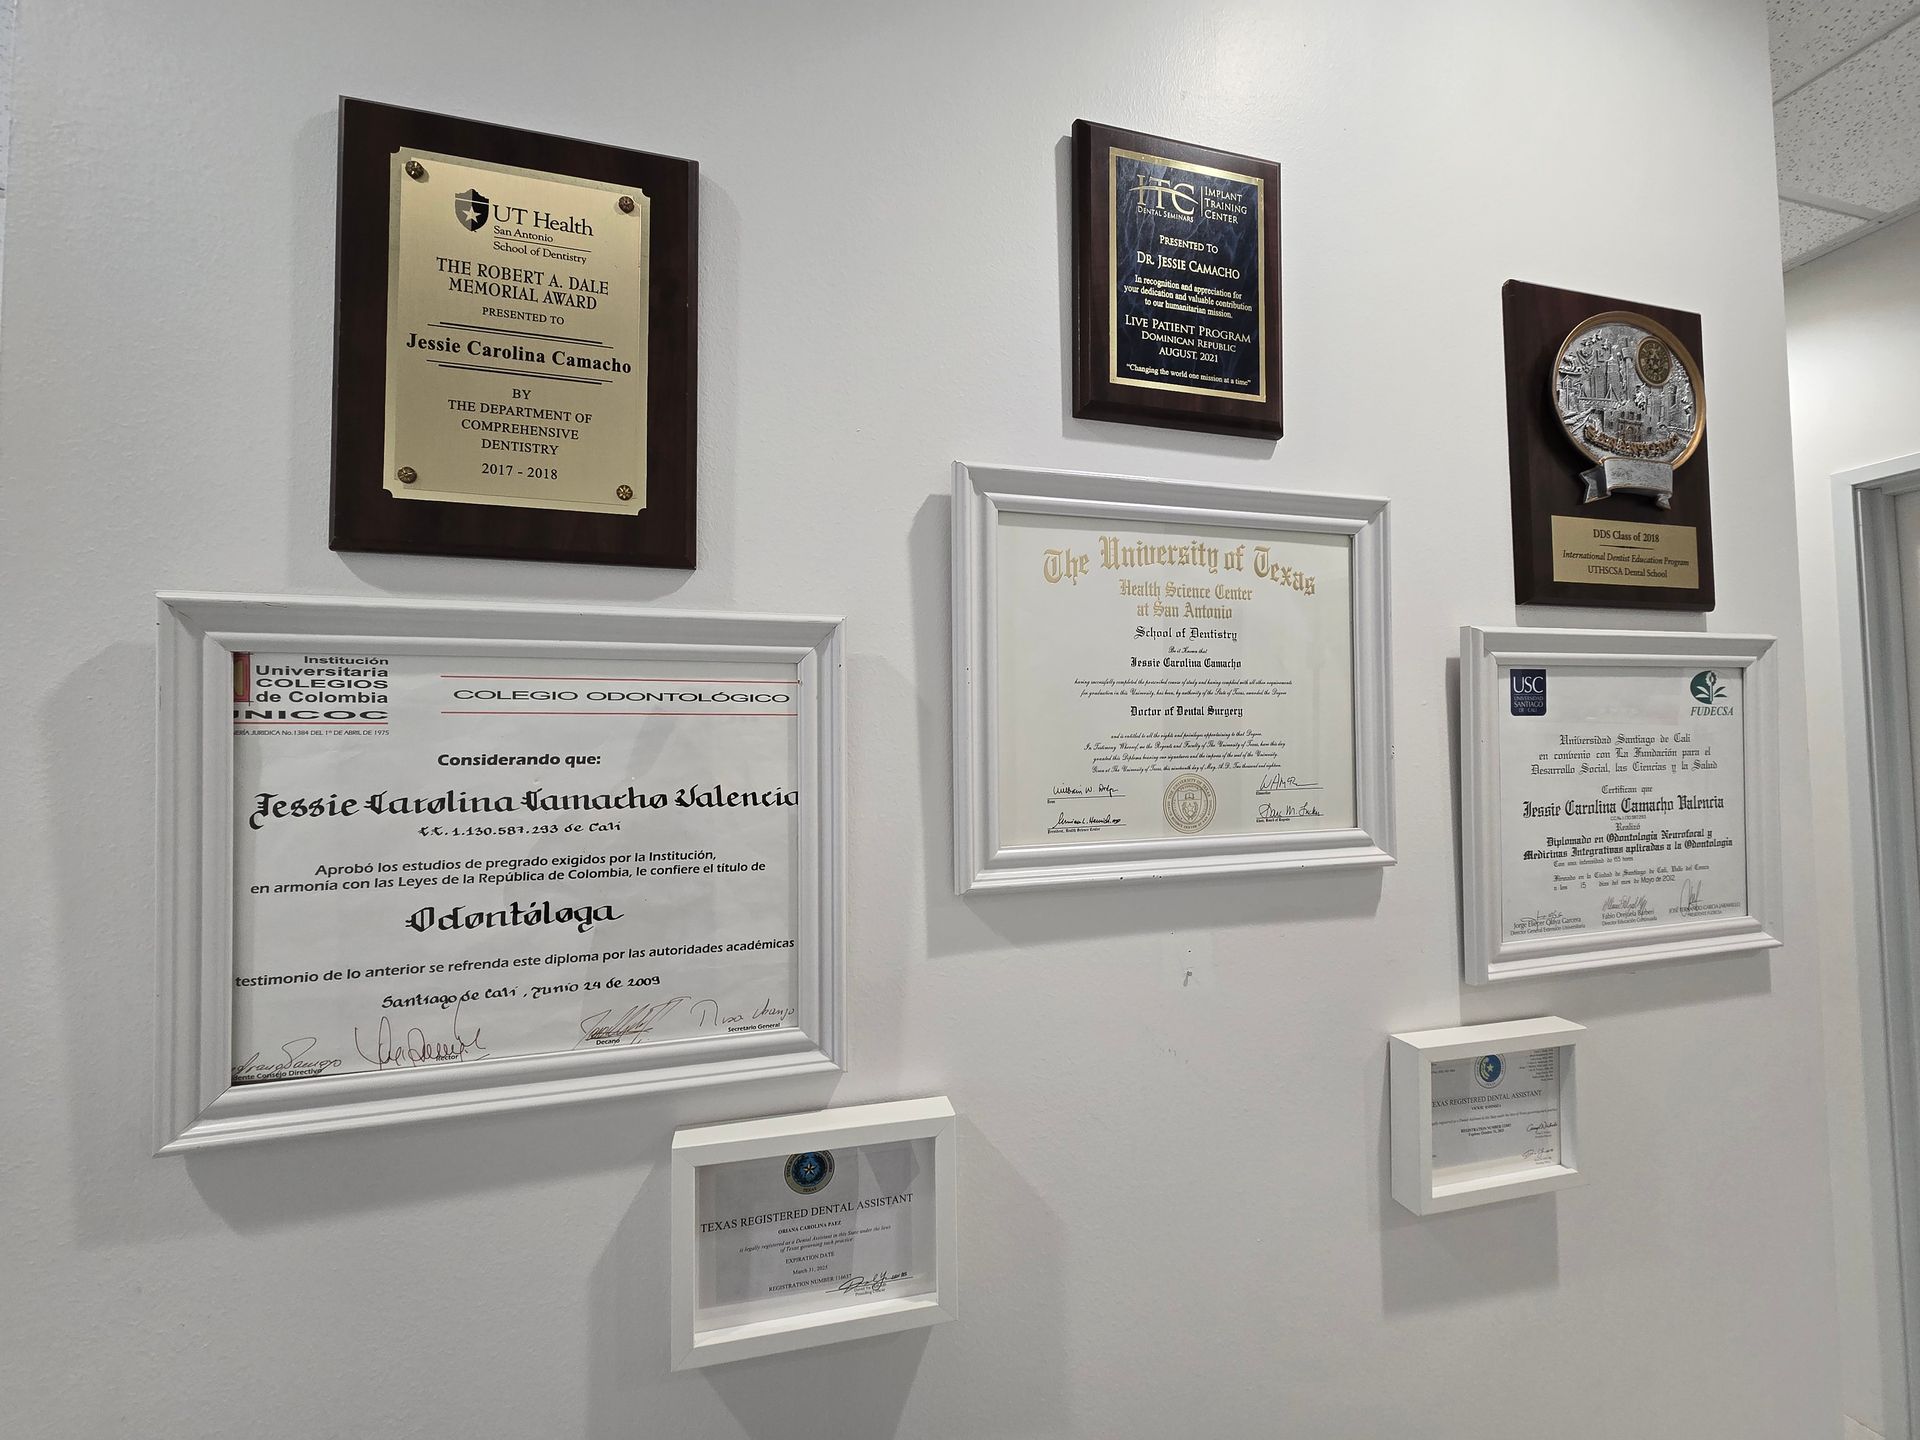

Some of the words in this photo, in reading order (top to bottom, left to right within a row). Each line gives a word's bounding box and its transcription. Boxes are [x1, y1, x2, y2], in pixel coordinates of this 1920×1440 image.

[1205, 186, 1242, 202] IMPLANT
[1136, 206, 1162, 217] DENTAL
[1163, 210, 1194, 223] SEMINARS
[1204, 198, 1247, 215] TRAINING
[493, 204, 528, 225] UT
[533, 211, 594, 236] Health
[1204, 209, 1238, 224] CENTER
[493, 225, 512, 236] San
[513, 229, 555, 244] Antonio
[493, 241, 527, 254] School
[530, 247, 541, 256] of
[543, 248, 587, 265] Dentistry
[1159, 235, 1204, 251] PRESENTED
[1206, 243, 1219, 254] TO
[1157, 254, 1186, 270] JESSIE
[1189, 260, 1240, 279] CAMACHO
[436, 257, 471, 276] THE
[477, 263, 544, 285] ROBERT
[548, 274, 563, 288] A.
[569, 276, 608, 295] DALE
[449, 277, 538, 302] MEMORIAL
[542, 290, 597, 310] AWARD
[482, 306, 547, 323] PRESENTED
[550, 316, 564, 325] TO
[1125, 314, 1148, 328] LIVE
[1152, 318, 1195, 335] PATIENT
[1199, 326, 1251, 343] PROGRAM
[1141, 330, 1194, 346] DOMINICAN
[1197, 339, 1236, 352] REPUBLIC
[406, 333, 461, 353] Jessie
[467, 340, 545, 363] Carolina
[552, 351, 631, 374] Camacho
[1200, 352, 1218, 363] 2021
[1200, 374, 1223, 382] mission
[512, 388, 531, 400] BY
[448, 399, 476, 412] THE
[480, 403, 572, 421] DEPARTMENT
[575, 413, 592, 424] OF
[461, 419, 579, 440] COMPREHENSIVE
[481, 438, 559, 455] DENTISTRY
[482, 463, 513, 476] 2017
[527, 467, 558, 480] 2018
[1593, 529, 1611, 539] DDS
[1612, 530, 1632, 541] Class
[1633, 532, 1641, 541] of
[1643, 533, 1660, 543] 2018
[1043, 548, 1090, 586] The
[1099, 535, 1219, 575] University
[1224, 543, 1246, 572] of
[1253, 545, 1316, 596] Texas
[1563, 549, 1606, 560] International
[1606, 553, 1630, 562] Dentist
[1631, 554, 1663, 564] Education
[1664, 557, 1689, 567] Program
[1587, 565, 1623, 575] UTHSCSA
[1624, 567, 1646, 576] Dental
[1646, 569, 1668, 578] School
[1119, 578, 1161, 600] Health
[1165, 581, 1211, 600] Science
[1214, 583, 1253, 601] Center
[1136, 604, 1149, 617] at
[1153, 601, 1179, 618] San
[1183, 602, 1233, 620] Antonio
[1133, 625, 1172, 640] School
[1176, 628, 1186, 638] of
[1189, 627, 1237, 642] Dentistry
[304, 656, 389, 665] Institución
[1130, 656, 1160, 667] Jessie
[1163, 657, 1202, 668] Carolina
[1204, 658, 1241, 670] Camacho
[256, 665, 388, 677] Universitaria
[256, 678, 388, 689] COLEGIOS
[1513, 676, 1544, 694] USC
[256, 691, 281, 702] de
[289, 691, 388, 703] Colombia
[454, 690, 578, 700] COLEGIO
[586, 692, 790, 703] ODONTOLÓGICO
[1130, 706, 1161, 716] Doctor
[1164, 706, 1175, 716] of
[1176, 705, 1204, 716] Dental
[1207, 705, 1243, 718] Surgery
[1690, 706, 1733, 716] FUDECSA
[1559, 734, 1611, 746] Universidad
[1615, 733, 1655, 747] Santiago
[1660, 734, 1669, 743] de
[1673, 732, 1691, 743] Cali
[438, 753, 560, 766] Considerando
[565, 756, 601, 768] que:
[249, 793, 359, 829] Jessie
[363, 790, 519, 814] Carolina
[520, 786, 667, 811] Camacho
[675, 784, 798, 808] Valencia
[1523, 801, 1561, 818] Jessie
[1565, 799, 1616, 817] Carolina
[1621, 797, 1674, 817] Camacho
[1677, 795, 1724, 810] Valencia
[564, 824, 583, 832] de
[589, 821, 621, 832] Cali
[1546, 835, 1591, 848] Diplomado
[315, 863, 373, 877] Aprobó
[378, 863, 398, 872] los
[402, 860, 461, 871] estudios
[465, 859, 482, 869] de
[485, 856, 548, 871] pregrado
[551, 855, 606, 868] exigidos
[609, 855, 631, 866] por
[635, 853, 645, 862] la
[649, 850, 716, 861] Institución,
[405, 900, 624, 933] Odontóloga
[381, 994, 460, 1008] Santiago
[459, 990, 479, 1002] de
[485, 986, 518, 998] Cali
[584, 981, 601, 990] 24
[606, 977, 623, 989] de
[627, 973, 660, 987] 2009
[727, 1025, 756, 1033] Secretario
[757, 1022, 781, 1030] General
[700, 1219, 737, 1233] TEXAS
[741, 1209, 808, 1227] REGISTERED
[811, 1202, 854, 1216] DENTAL
[857, 1193, 913, 1210] ASSISTANT
[785, 1254, 819, 1264] EXPIRATION
[820, 1251, 834, 1259] DATE
[769, 1281, 809, 1292] REGISTRATION
[810, 1276, 834, 1285] NUMBER
